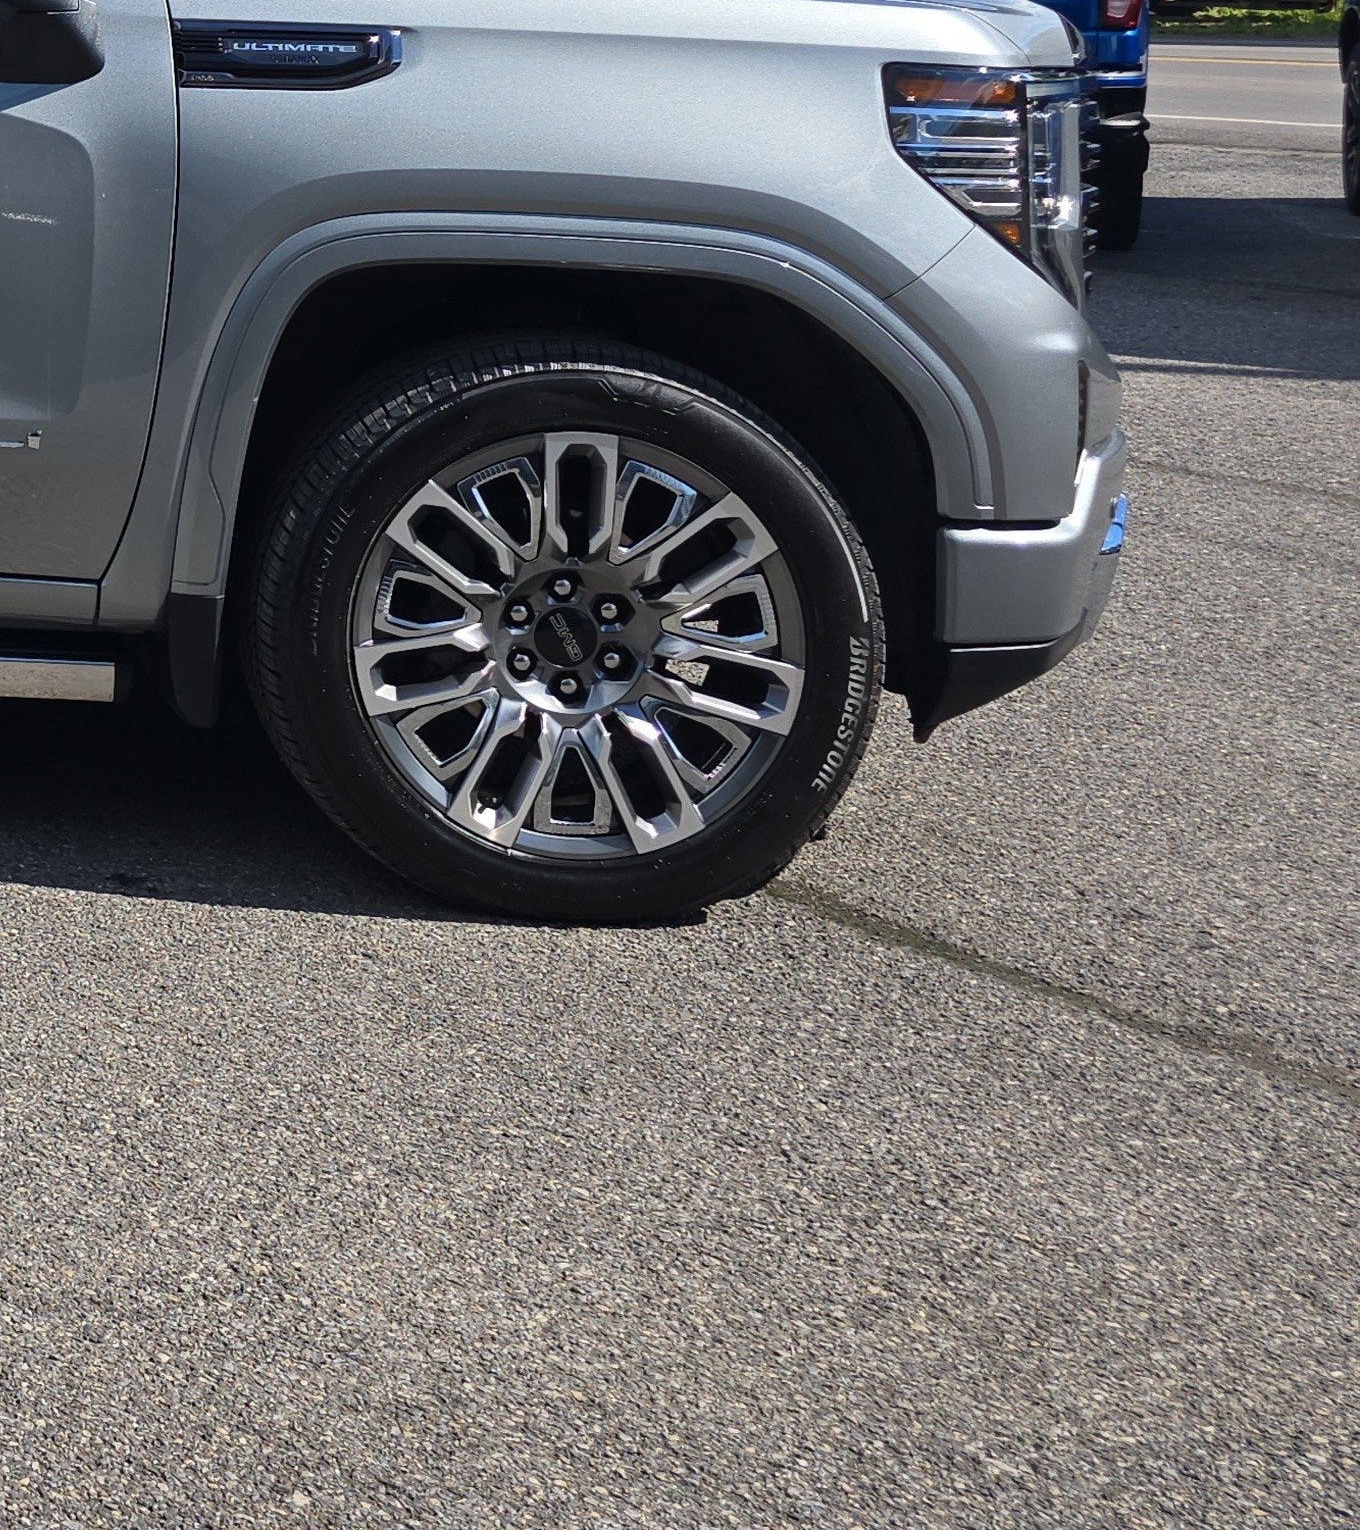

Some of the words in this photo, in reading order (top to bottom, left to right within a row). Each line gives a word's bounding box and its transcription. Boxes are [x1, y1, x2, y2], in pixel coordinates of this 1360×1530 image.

[233, 42, 357, 53] ULTIMATE
[549, 613, 583, 662] GMC
[811, 635, 871, 796] BRIDGESTONE
